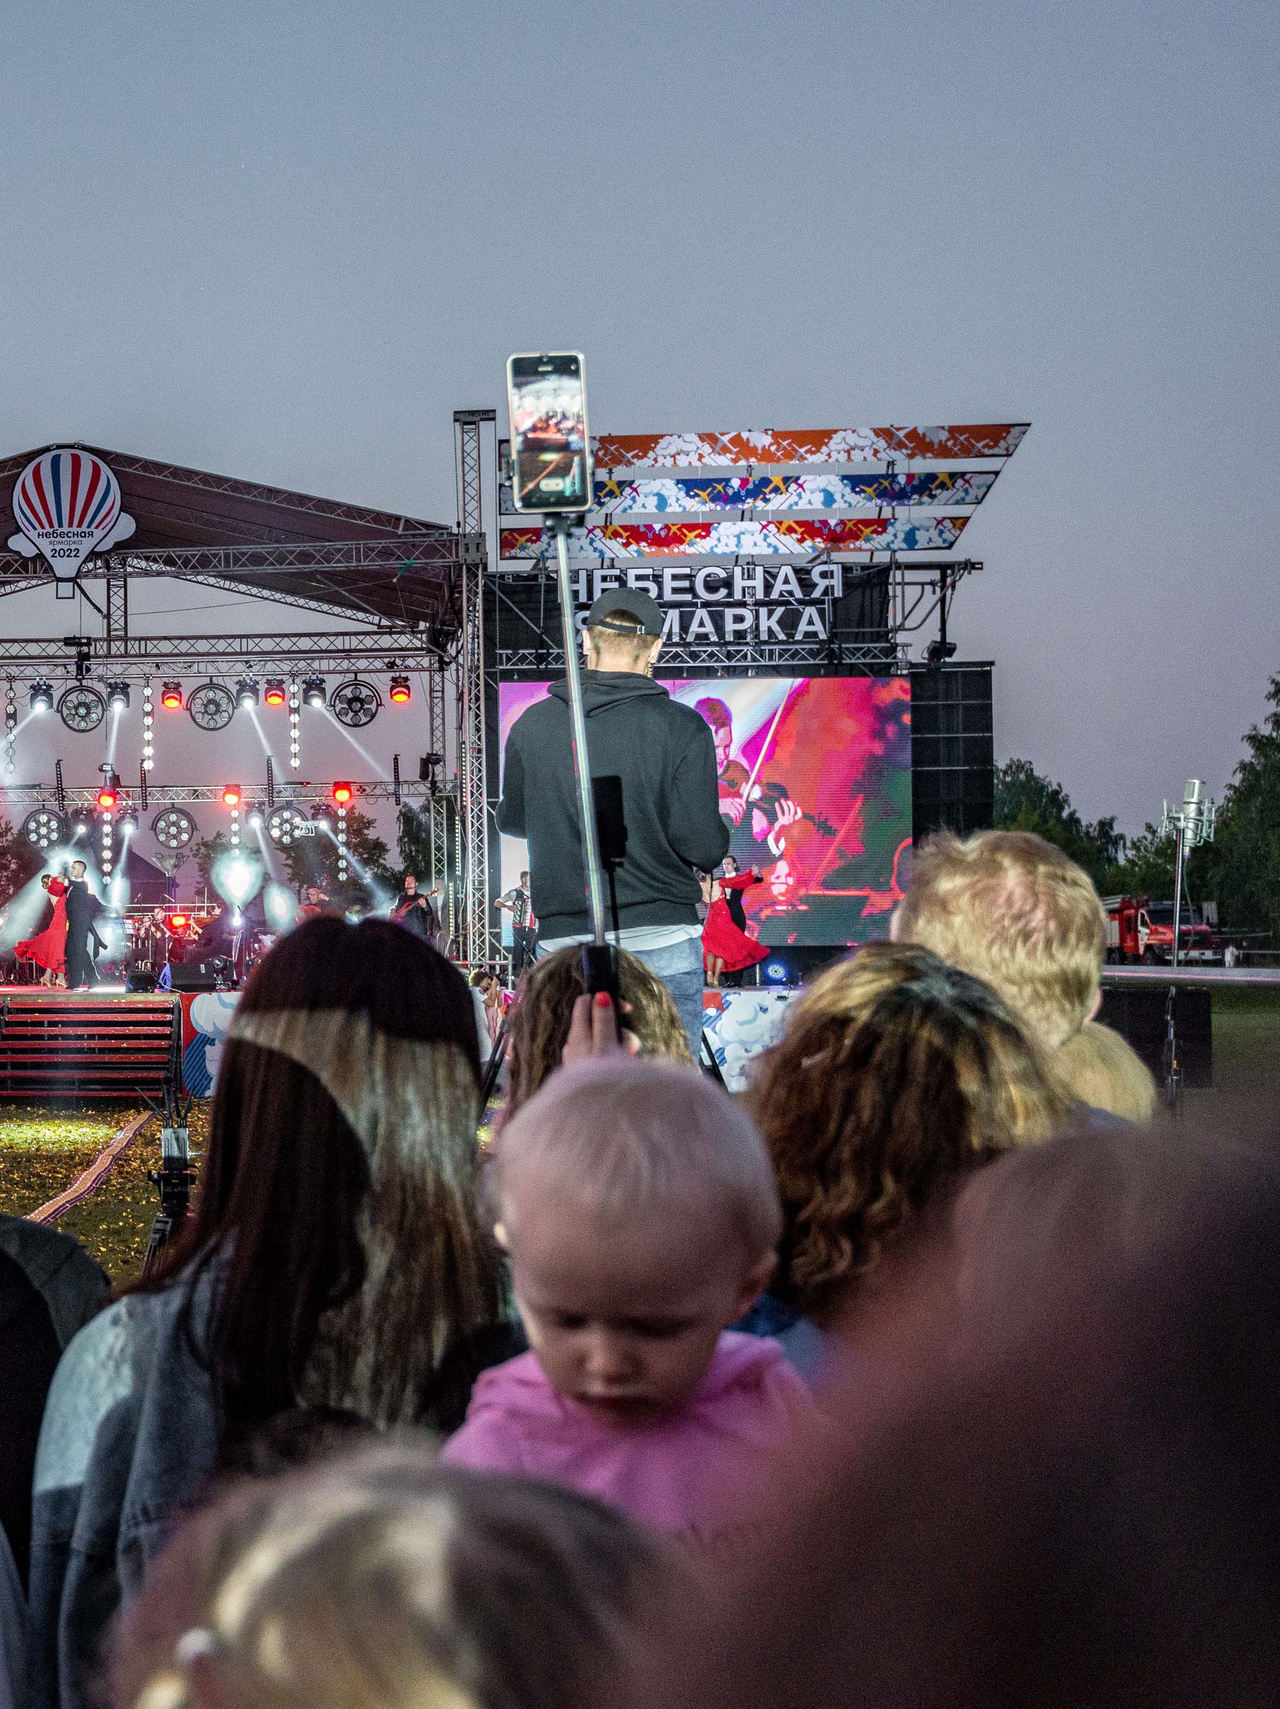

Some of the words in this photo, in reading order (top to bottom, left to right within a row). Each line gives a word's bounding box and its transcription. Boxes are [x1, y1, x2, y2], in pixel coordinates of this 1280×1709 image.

[37, 529, 94, 539] небесная
[50, 548, 80, 558] 2022
[573, 606, 828, 644] МАРКА
